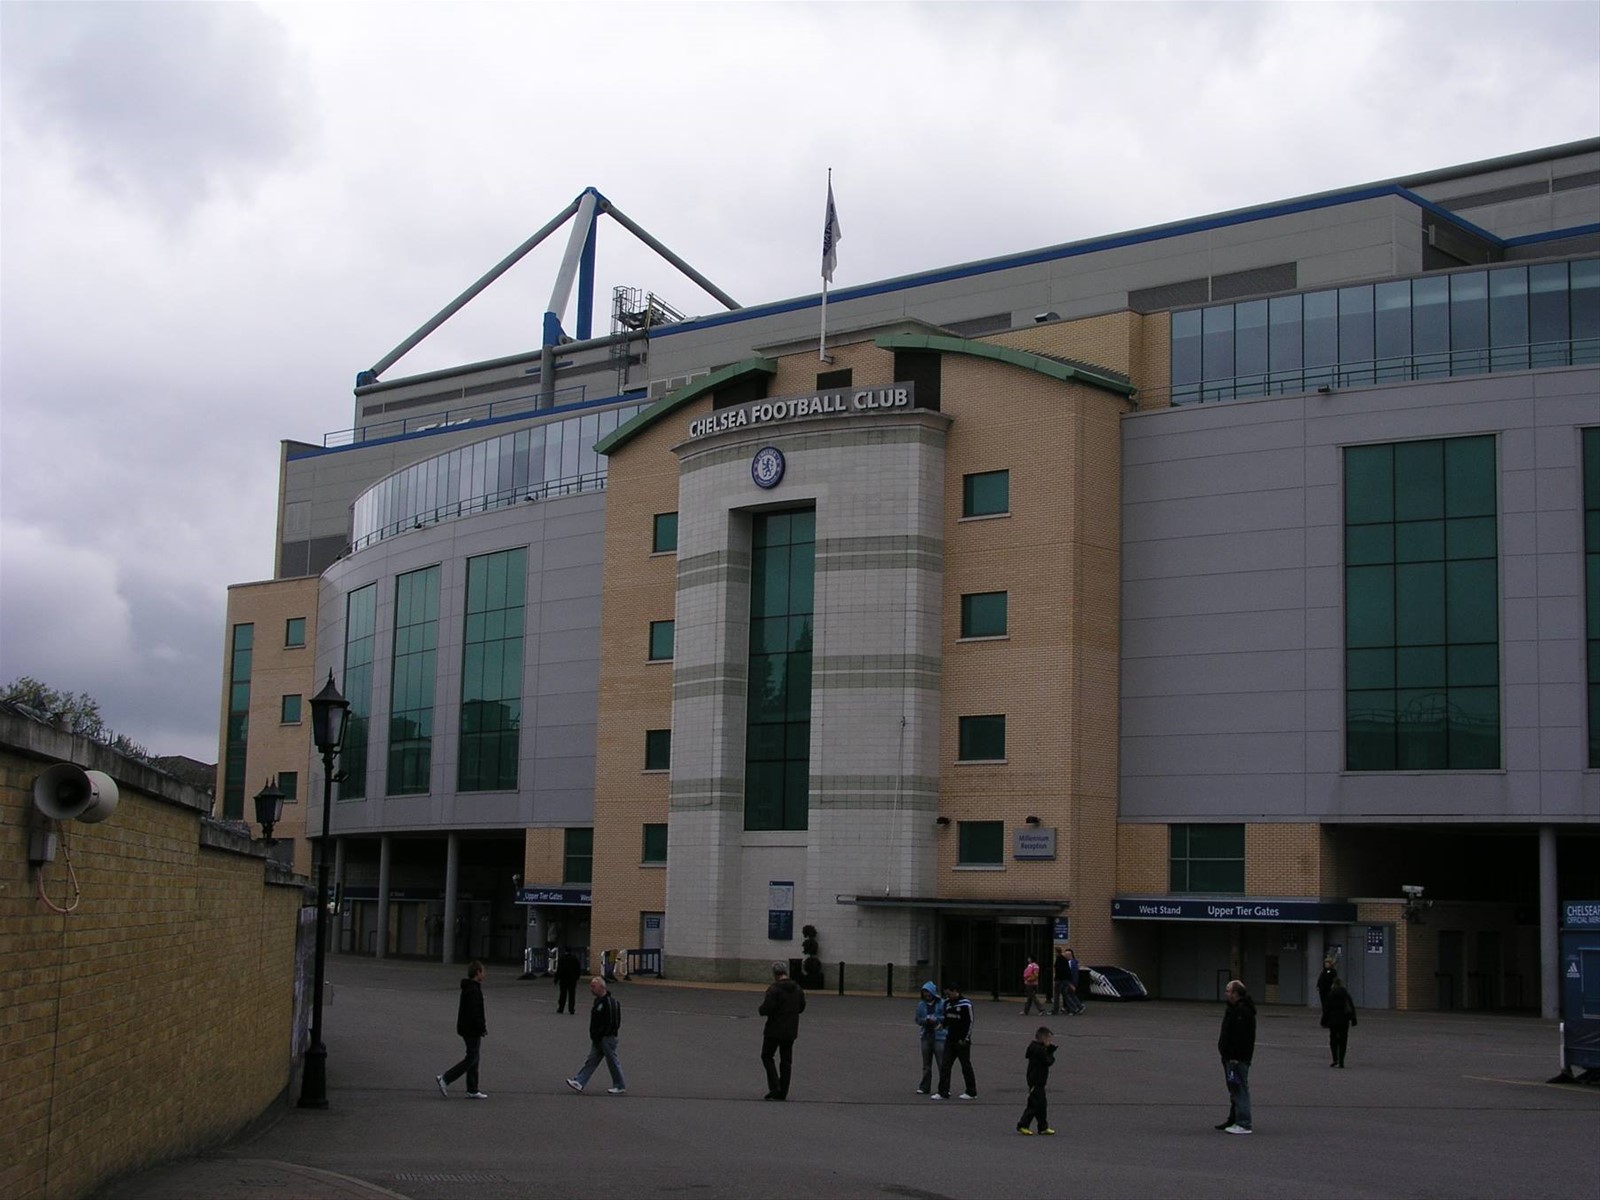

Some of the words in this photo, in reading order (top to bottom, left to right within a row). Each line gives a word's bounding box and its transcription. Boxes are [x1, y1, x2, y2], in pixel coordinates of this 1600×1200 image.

[689, 409, 747, 437] CHELSEA
[751, 394, 846, 423] FOOTBALL
[853, 388, 908, 409] CLUB
[1139, 905, 1158, 914] West
[1159, 905, 1181, 914] Stand
[1207, 905, 1234, 917] Upper
[1235, 905, 1252, 915] Tier
[1254, 906, 1280, 916] Gates
